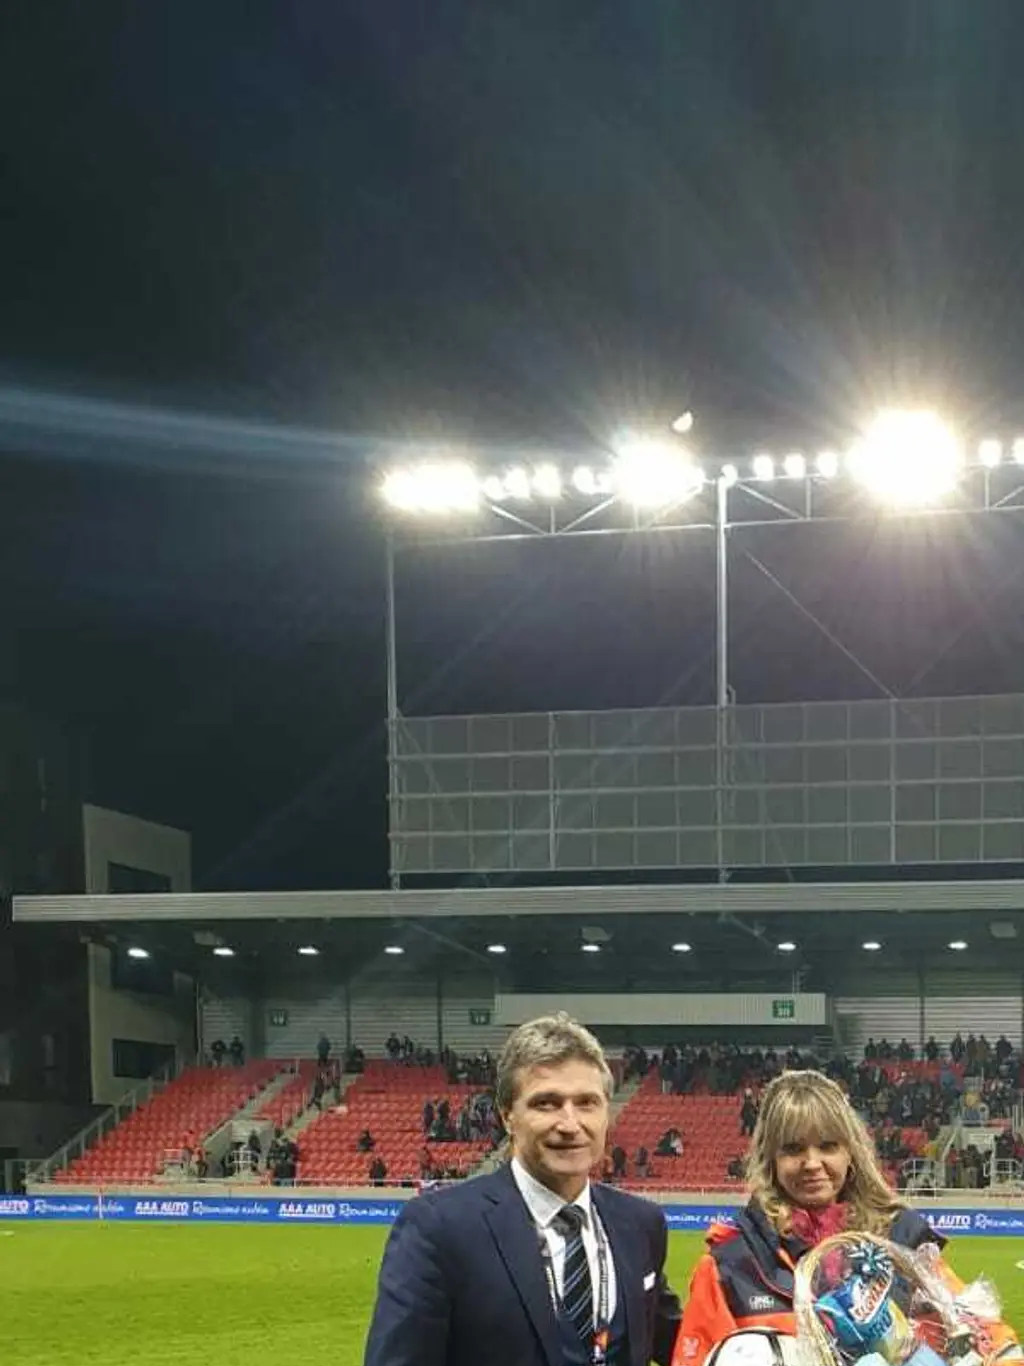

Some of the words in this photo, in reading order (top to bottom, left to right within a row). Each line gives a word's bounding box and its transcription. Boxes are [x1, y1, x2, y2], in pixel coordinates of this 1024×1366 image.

[160, 1202, 188, 1214] AUTO
[279, 1204, 303, 1216] AAA
[305, 1204, 335, 1216] AUTO
[939, 1215, 970, 1226] AUTO
